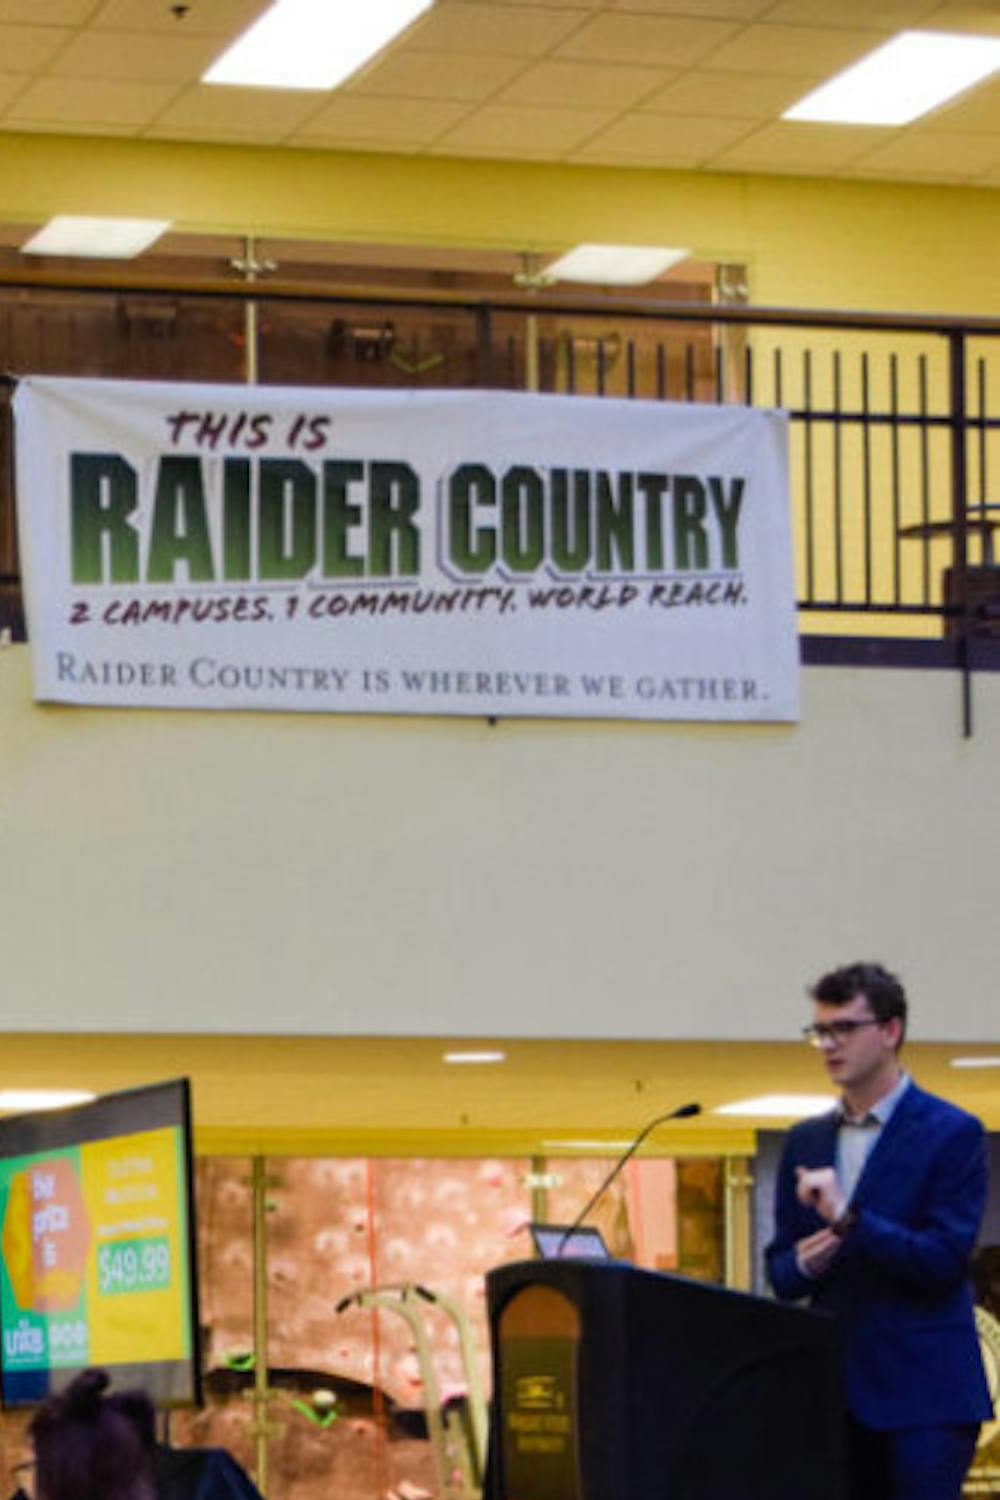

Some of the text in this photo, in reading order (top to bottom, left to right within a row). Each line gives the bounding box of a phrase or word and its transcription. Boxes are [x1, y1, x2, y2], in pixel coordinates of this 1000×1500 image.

[165, 410, 331, 449] THIS IS
[69, 452, 745, 584] RAIDER COUNTRY
[69, 581, 748, 625] 2 CAMPUSES. 1 COMMUNITY. WORLD REACH.
[99, 1244, 170, 1292] $49.99
